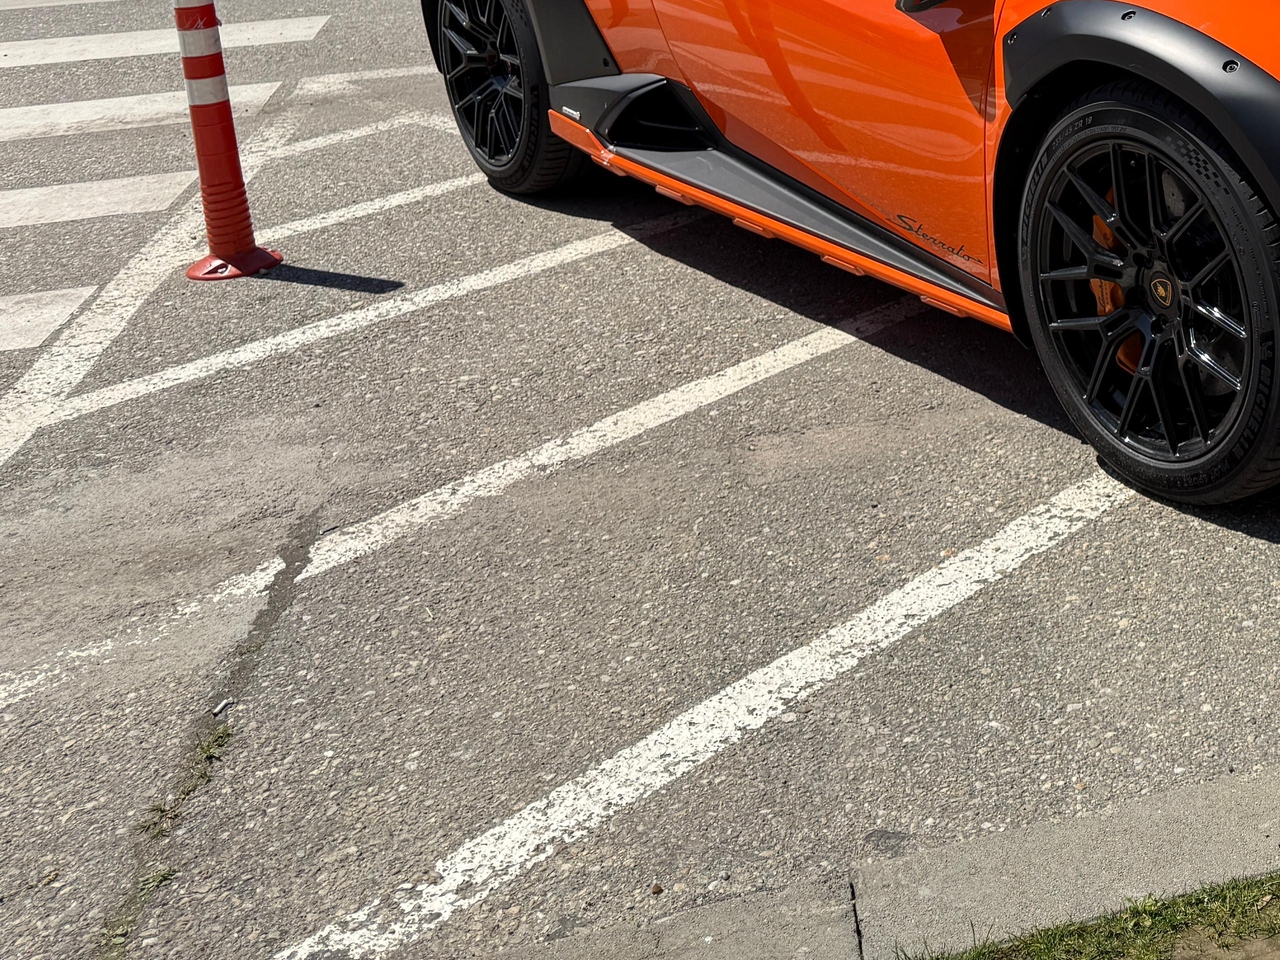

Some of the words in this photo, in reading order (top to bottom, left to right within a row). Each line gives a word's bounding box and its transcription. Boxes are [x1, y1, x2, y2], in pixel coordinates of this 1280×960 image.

[1085, 115, 1093, 126] 19
[1022, 151, 1049, 244] MICHELIN
[894, 214, 983, 265] Sterrato
[1232, 363, 1272, 461] MICHELIN
